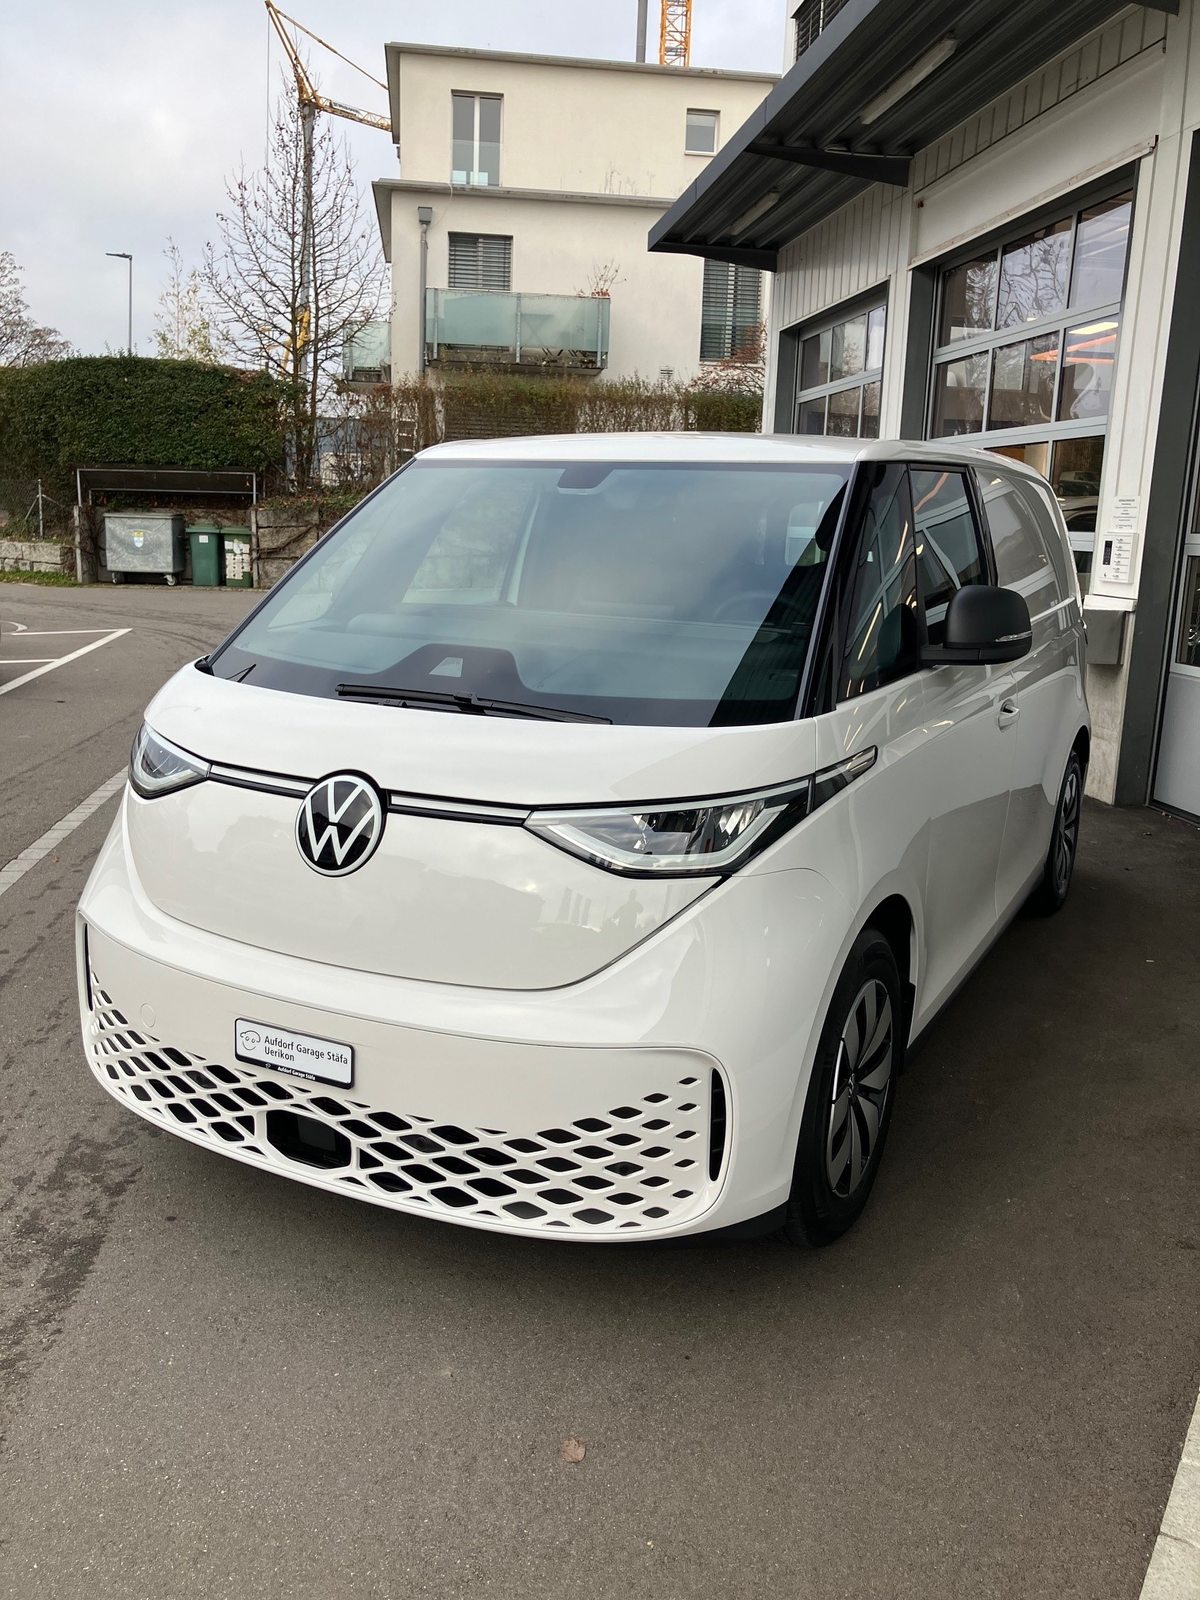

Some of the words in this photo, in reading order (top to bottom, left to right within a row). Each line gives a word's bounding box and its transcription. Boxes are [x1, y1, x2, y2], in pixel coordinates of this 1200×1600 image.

[300, 776, 379, 871] VW
[264, 1035, 294, 1051] Aufdorf
[296, 1043, 325, 1059] Garage
[327, 1051, 348, 1065] Stäfa
[264, 1046, 295, 1062] Uerikon
[292, 1069, 306, 1078] Garage
